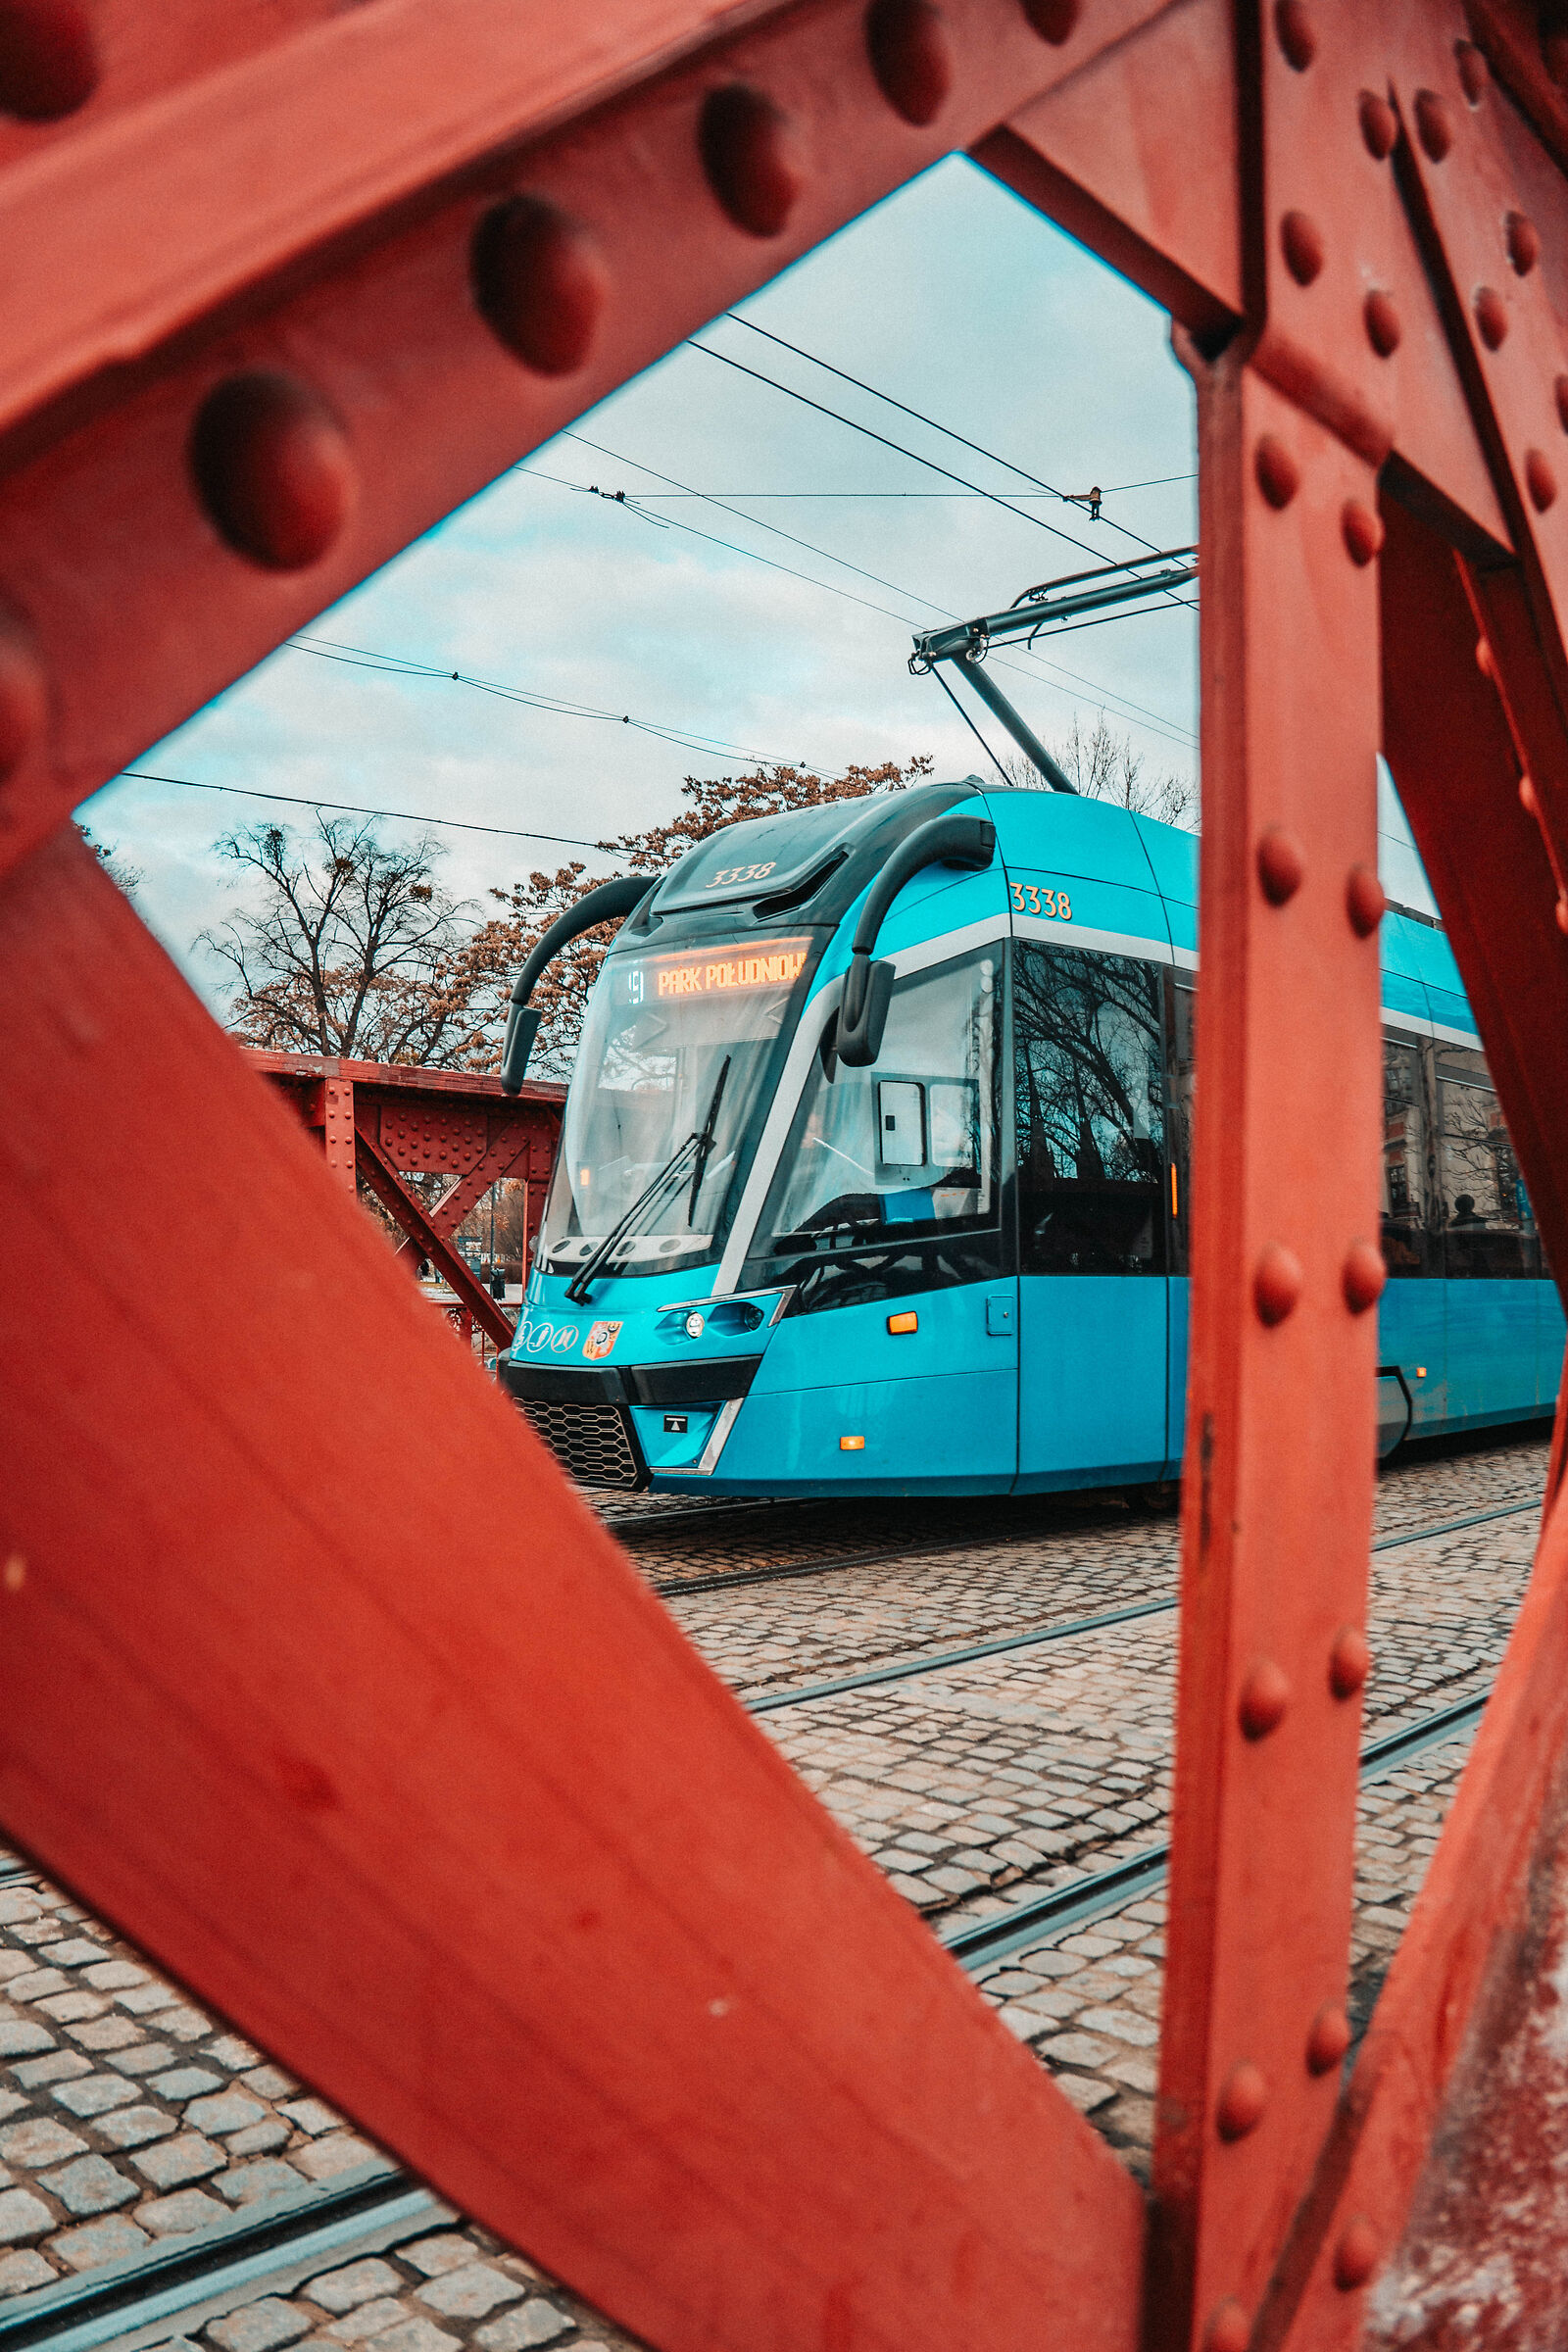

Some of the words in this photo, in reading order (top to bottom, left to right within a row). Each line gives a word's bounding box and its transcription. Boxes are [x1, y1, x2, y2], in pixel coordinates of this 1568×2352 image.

[706, 861, 776, 888] 3338
[1009, 881, 1072, 921] 3338
[628, 970, 644, 1004] 9
[659, 965, 703, 996] PARK
